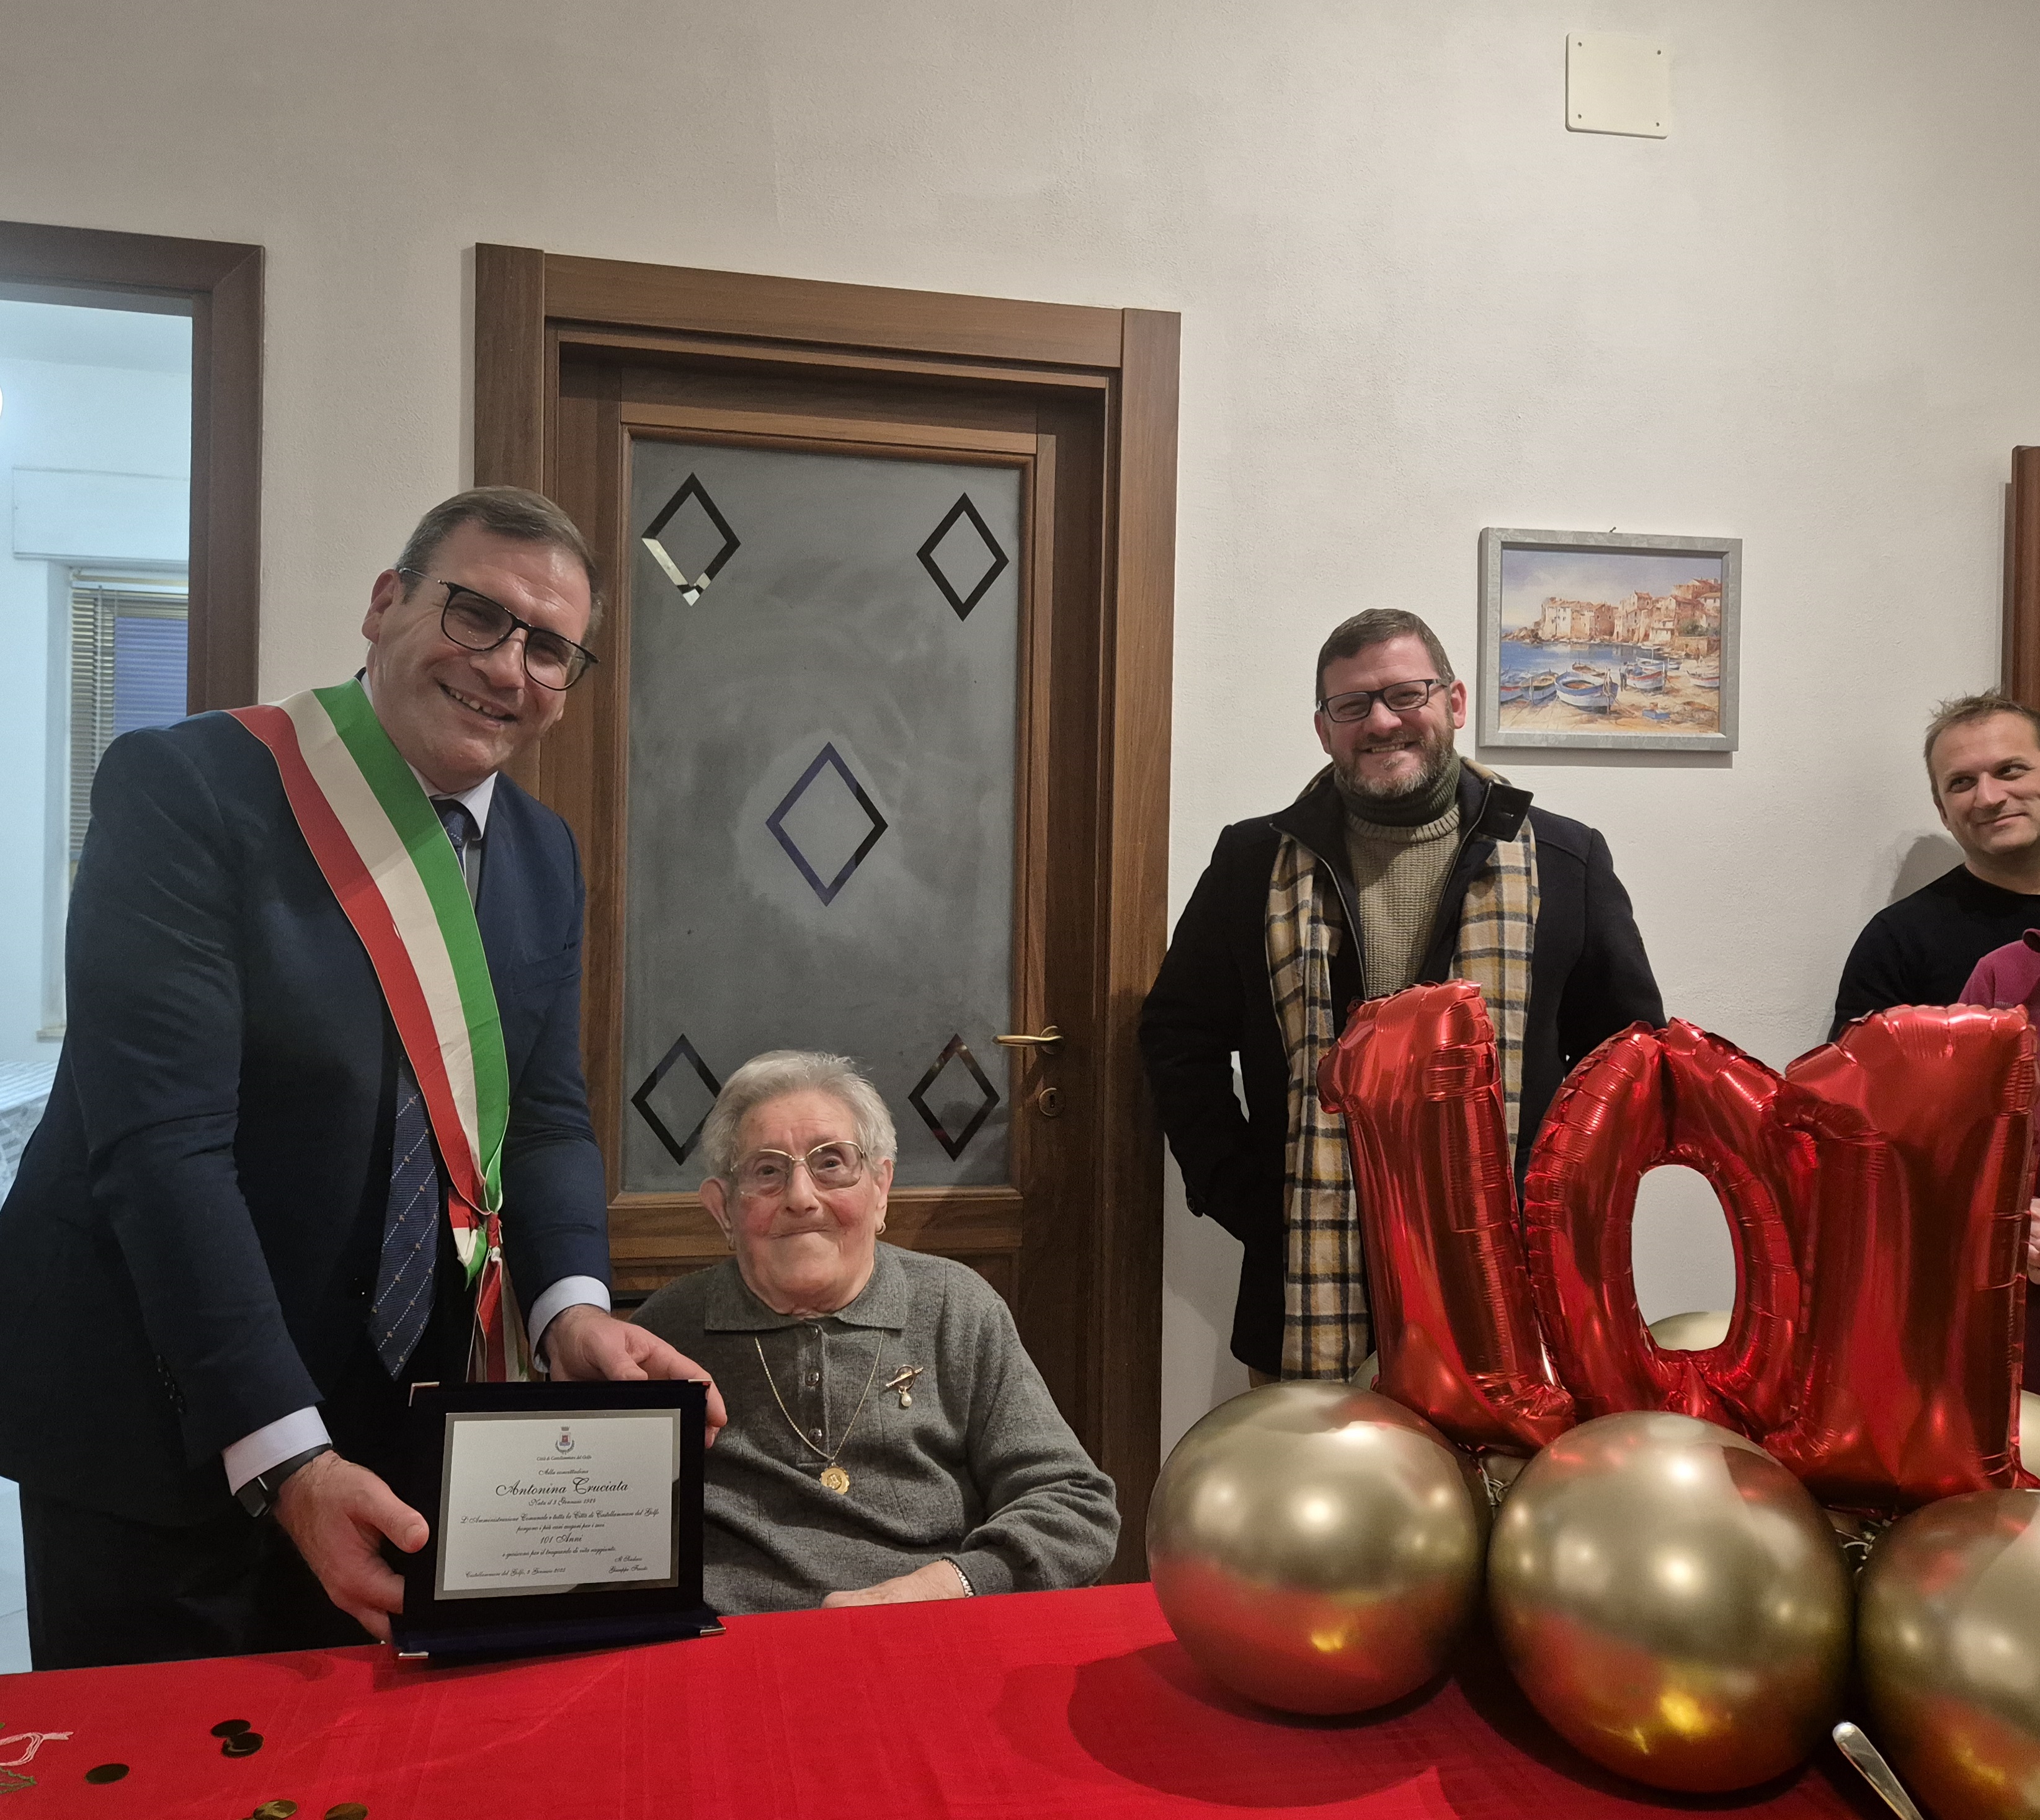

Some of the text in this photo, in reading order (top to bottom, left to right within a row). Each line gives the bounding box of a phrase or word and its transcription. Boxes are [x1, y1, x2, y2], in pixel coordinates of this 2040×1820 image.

[1318, 978, 2036, 1511] 101
[496, 1477, 628, 1496] Antonina Cruciata
[528, 1498, 546, 1506] Nata
[558, 1496, 582, 1506] Gennaio
[460, 1515, 519, 1524] L'Amministrazione
[520, 1513, 548, 1521] Comunale
[573, 1511, 587, 1519] Città
[595, 1509, 634, 1518] Castellammare
[644, 1507, 659, 1517] Golfo
[516, 1526, 538, 1534] porgono
[563, 1522, 581, 1532] auguri
[540, 1532, 583, 1544] 101 Anni
[529, 1550, 539, 1558] per
[546, 1548, 571, 1558] traguardo
[531, 1567, 553, 1575] Gennaio
[608, 1566, 629, 1574] Giuseppe
